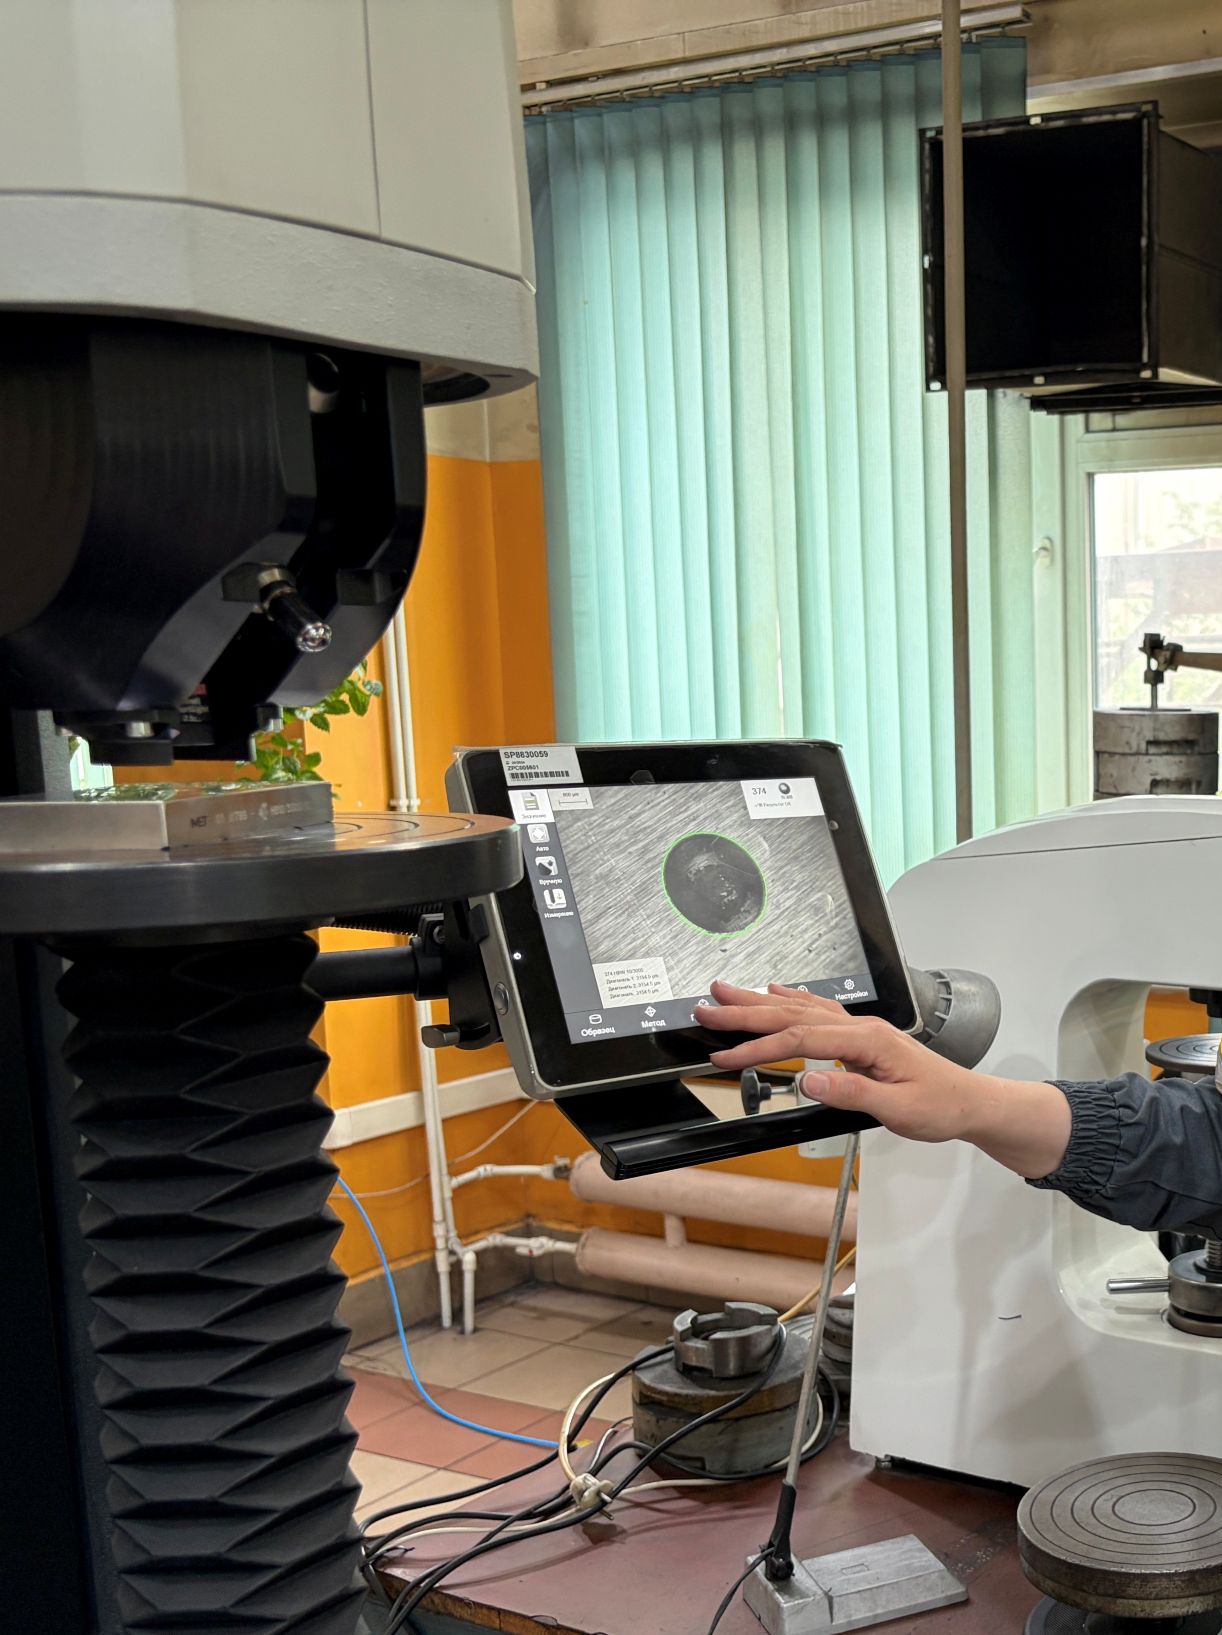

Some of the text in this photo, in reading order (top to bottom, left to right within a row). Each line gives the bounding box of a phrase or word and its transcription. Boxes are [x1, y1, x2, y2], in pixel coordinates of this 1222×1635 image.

[751, 787, 767, 795] 374
[835, 990, 868, 1000] Настройки
[641, 1019, 666, 1028] Метод
[581, 1027, 616, 1038] Образец
